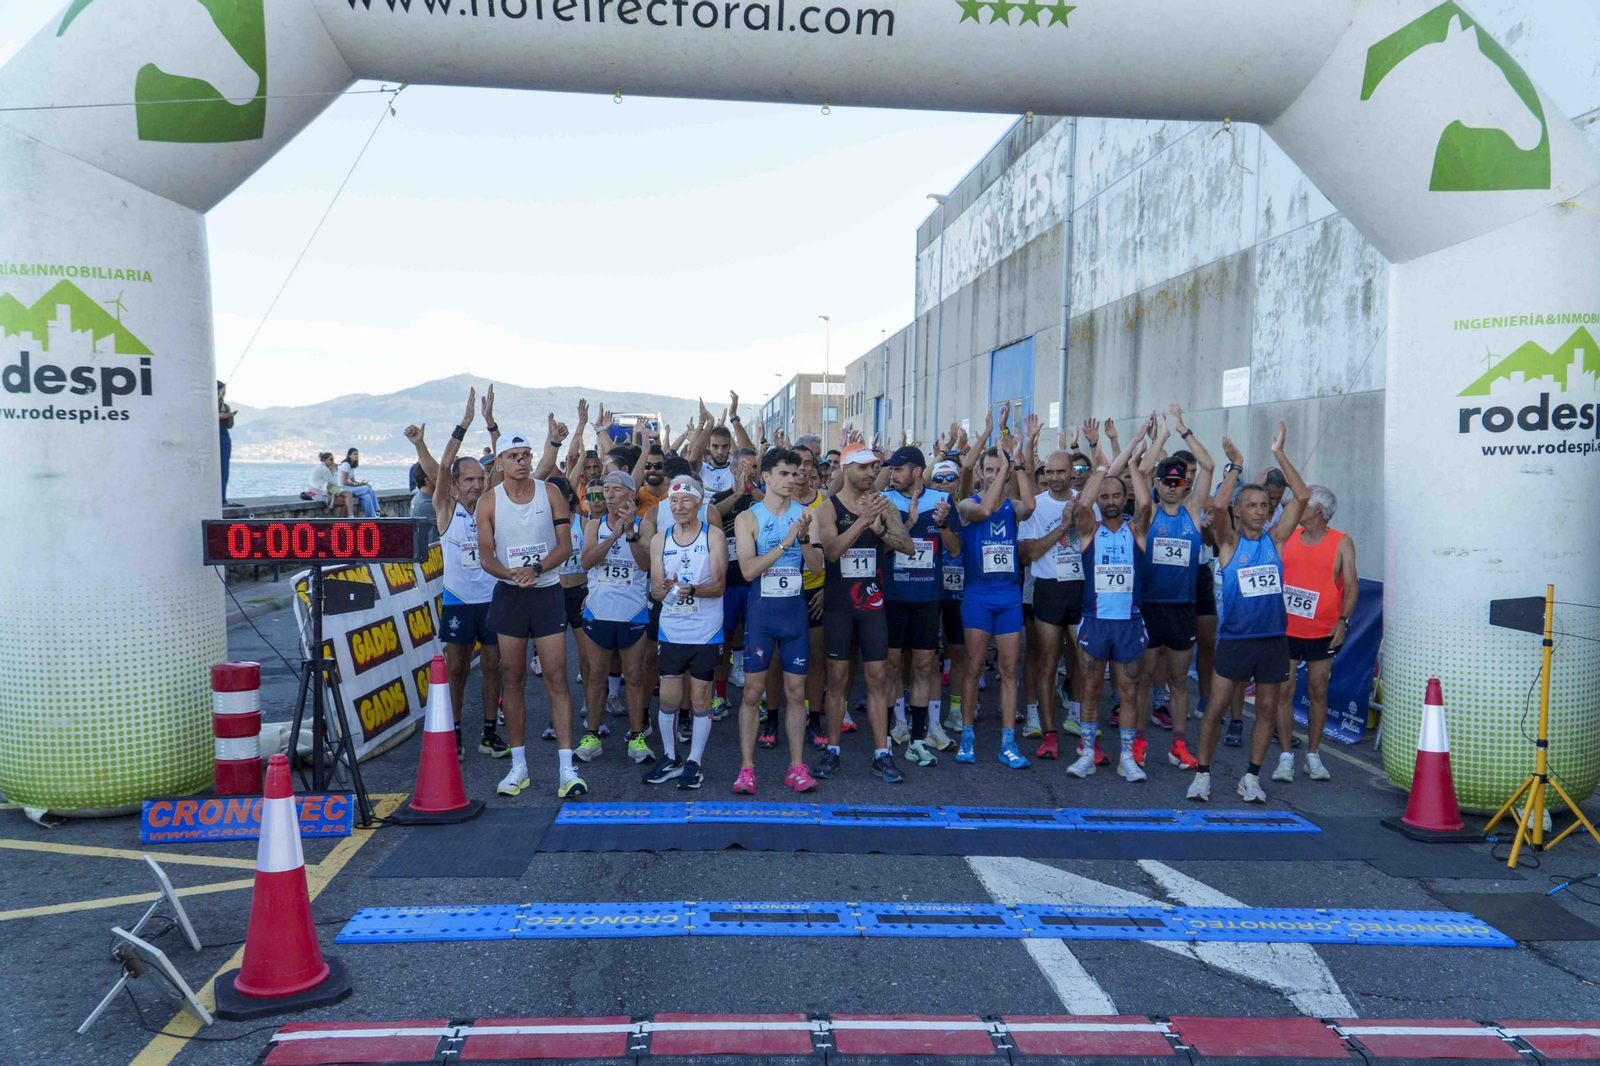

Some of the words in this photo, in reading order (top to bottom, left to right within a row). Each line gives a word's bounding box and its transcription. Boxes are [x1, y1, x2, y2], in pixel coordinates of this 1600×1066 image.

[227, 522, 380, 558] 0:00:00
[908, 550, 925, 561] 27
[1165, 546, 1183, 558] 34
[853, 557, 868, 569] 11
[994, 553, 1008, 565] 66
[603, 566, 629, 578] 153
[779, 576, 788, 589] 6
[946, 574, 961, 584] 43
[1106, 574, 1125, 585] 70
[1249, 574, 1276, 588] 152
[1287, 595, 1313, 610] 156
[352, 621, 397, 664] GADIS
[361, 682, 406, 731] GADIS
[148, 795, 347, 827] CRONEC
[694, 809, 809, 817] CRONOTEC
[397, 907, 479, 915] CRONOTEC
[524, 914, 679, 926] CRONOTEC
[1188, 919, 1332, 931] CRONOTEC
[1347, 922, 1490, 934] CRONOTEC
